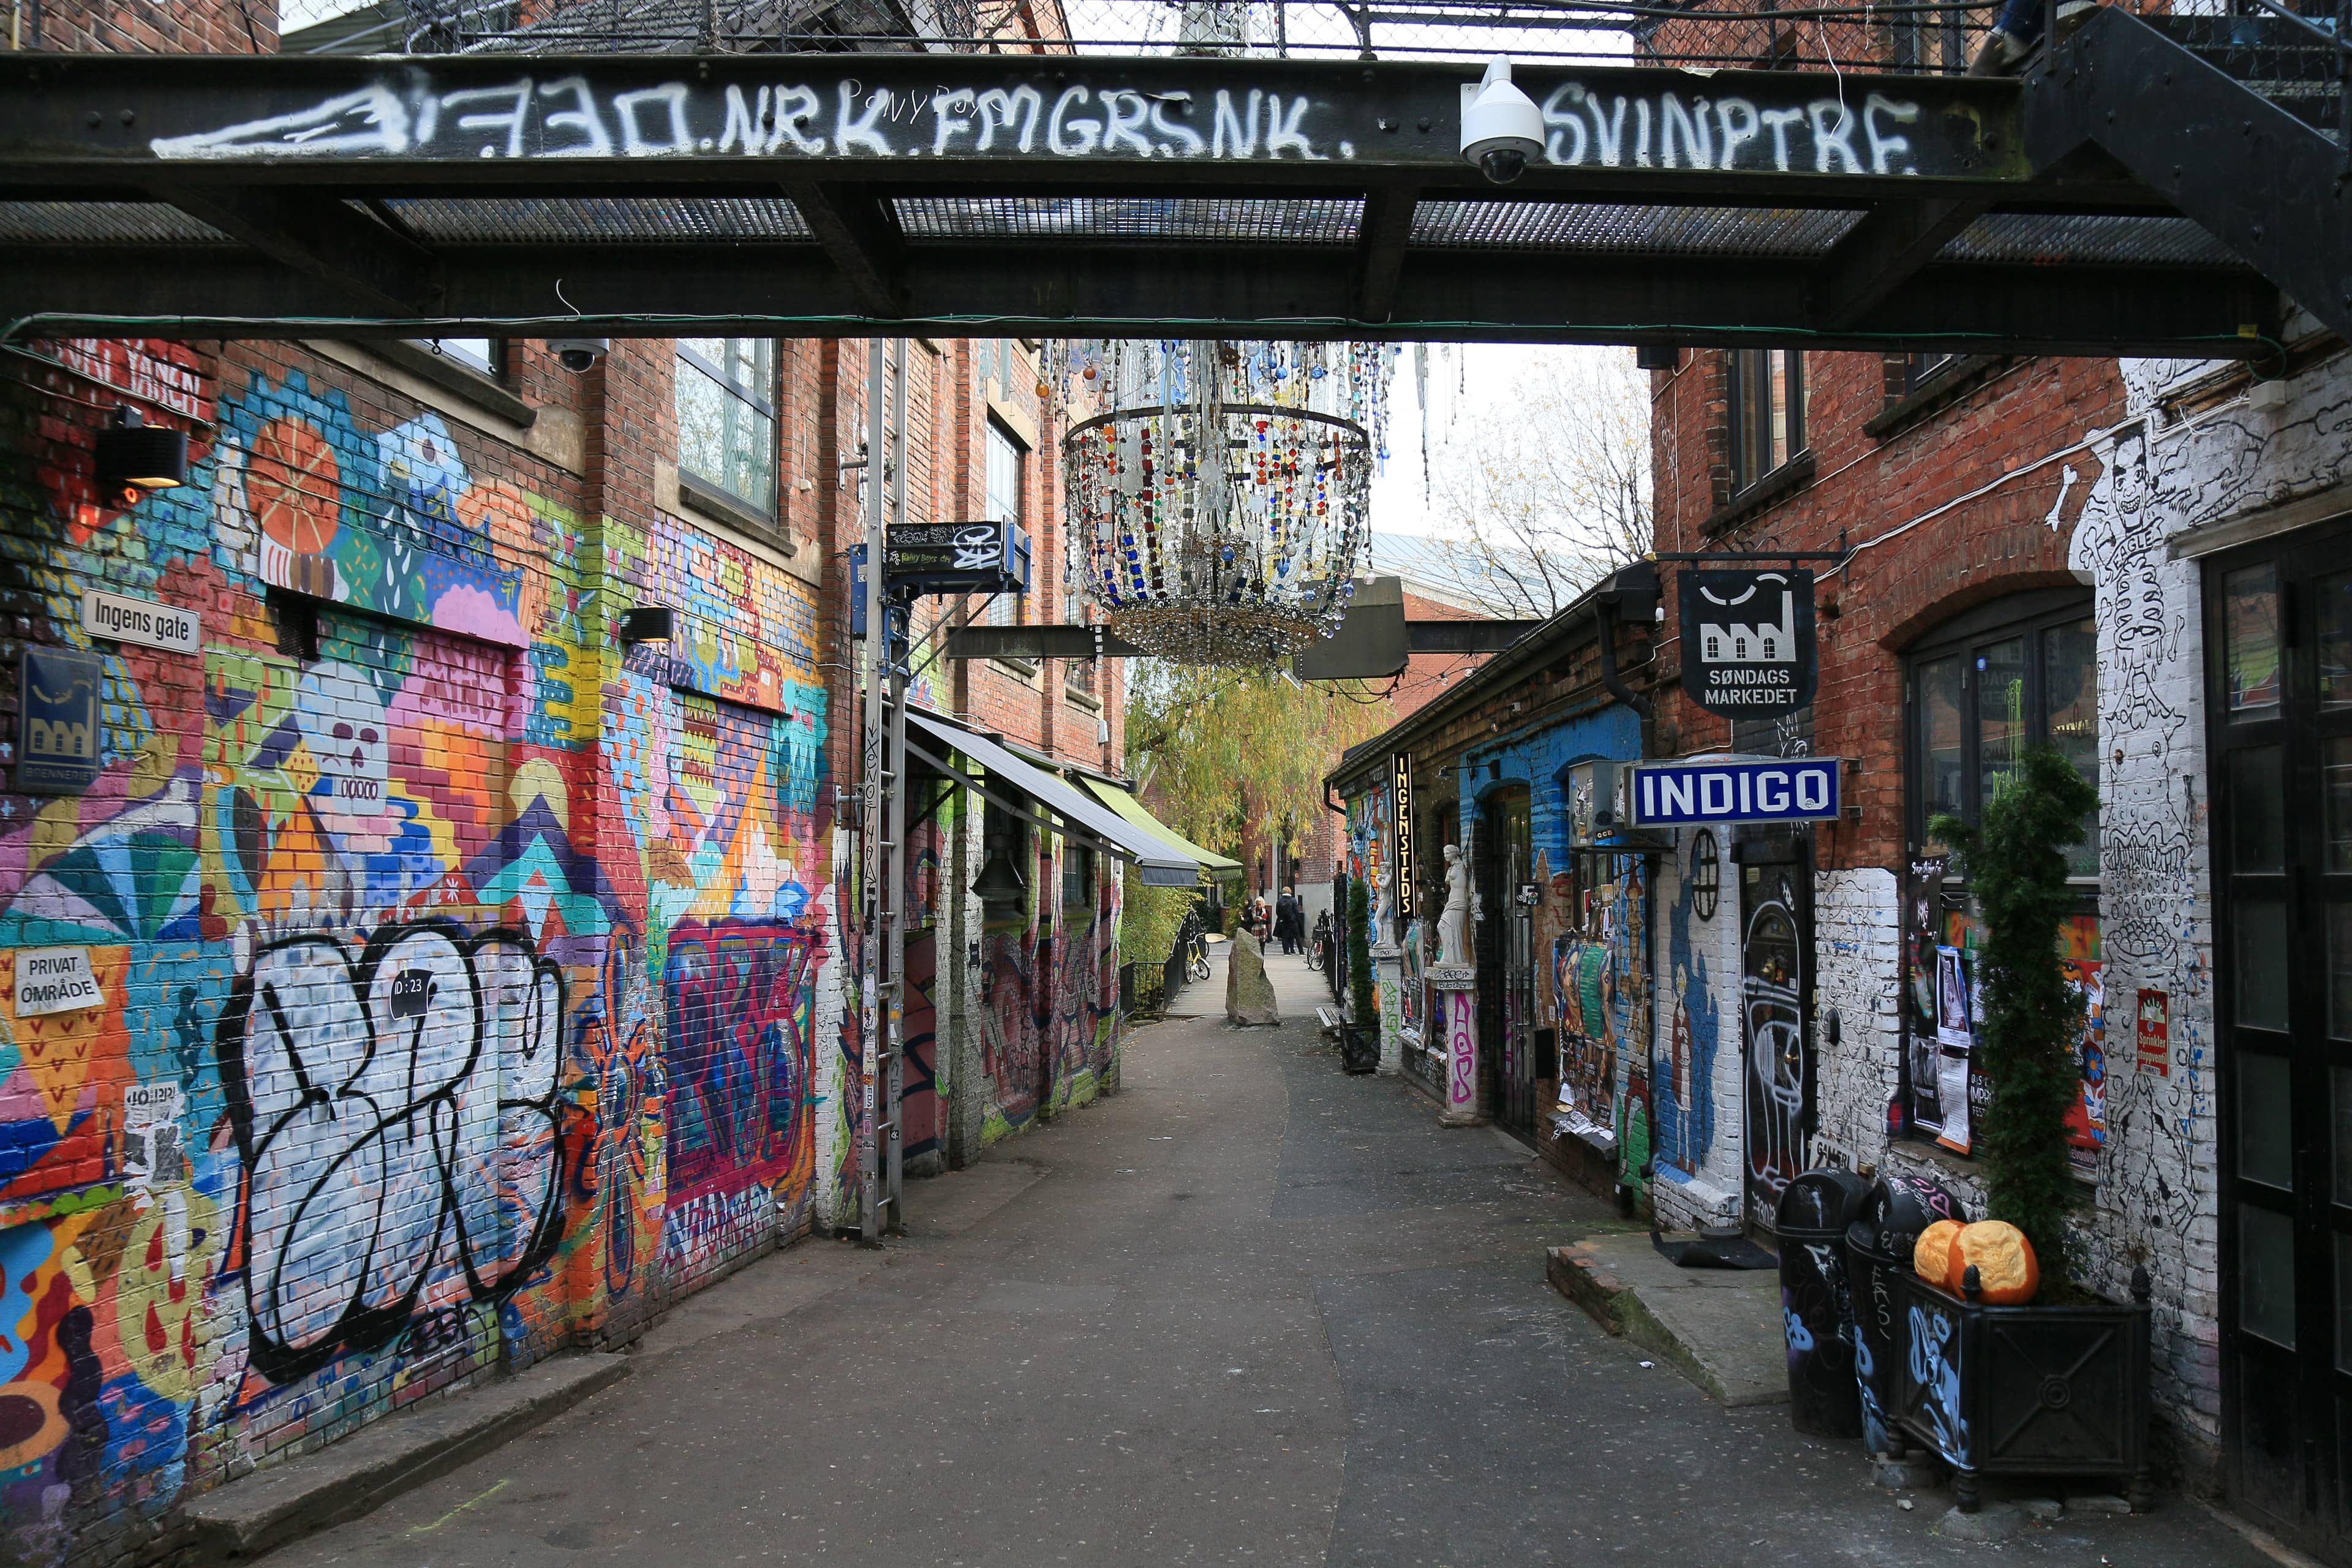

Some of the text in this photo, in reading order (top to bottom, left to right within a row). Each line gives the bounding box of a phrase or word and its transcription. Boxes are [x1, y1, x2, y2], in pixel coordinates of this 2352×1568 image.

[2113, 532, 2153, 568] EAGLE
[95, 597, 189, 641] Ingens gate
[1709, 669, 1790, 685] SØNDAGS
[1705, 688, 1798, 705] MARKEDET
[1643, 769, 1829, 816] INDIGO
[1396, 757, 1411, 913] INGENSTEDS
[1597, 829, 1613, 839] OCB
[29, 956, 78, 976] PRIVAT
[21, 978, 95, 1005] OMRÅDE
[410, 978, 422, 993] 23
[2138, 1031, 2166, 1049] Sprinkler
[2137, 1049, 2168, 1066] stoppventil
